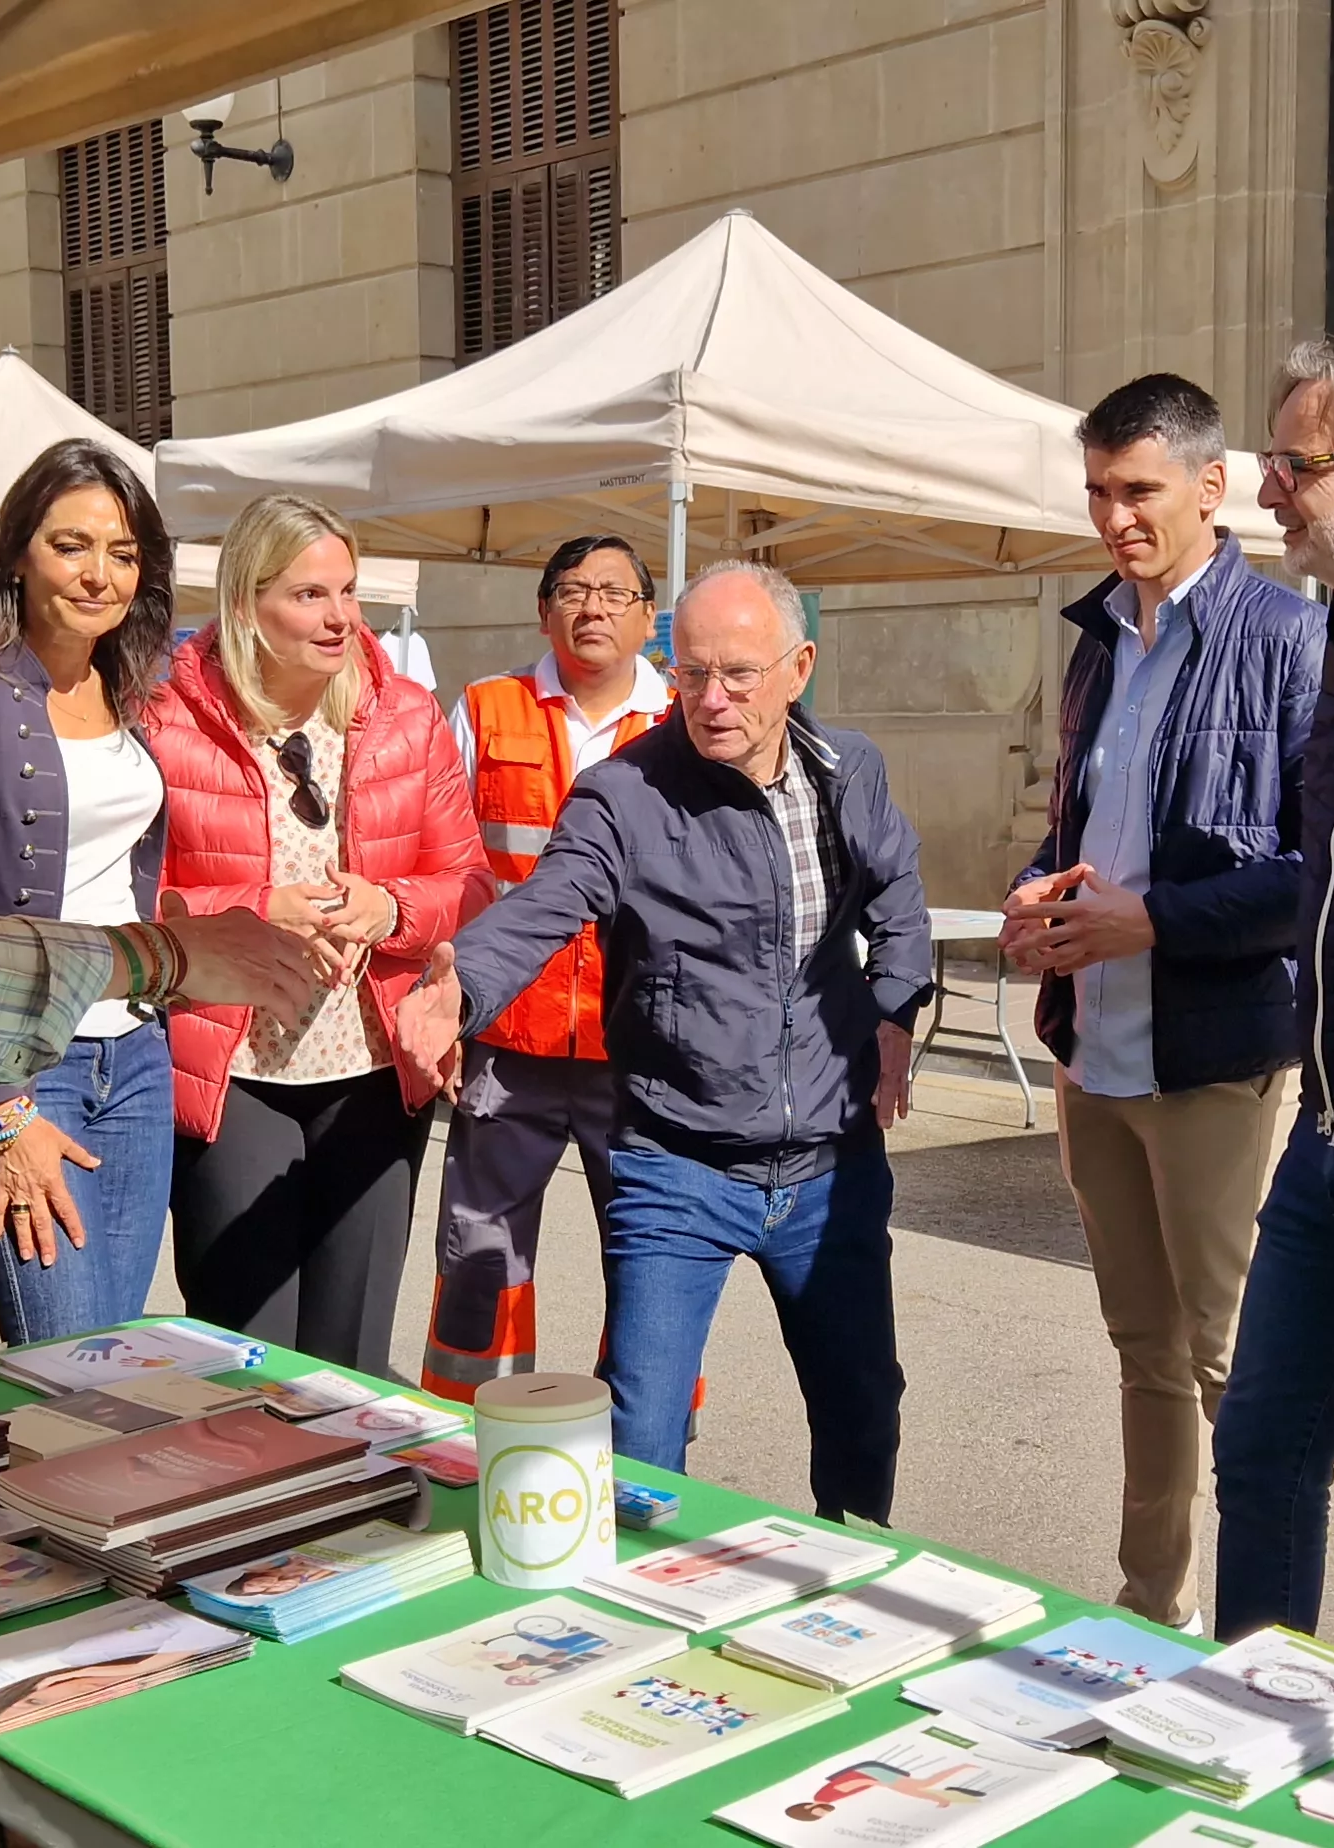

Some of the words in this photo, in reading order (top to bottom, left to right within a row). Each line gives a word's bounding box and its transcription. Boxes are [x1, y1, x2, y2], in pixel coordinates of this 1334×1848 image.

[600, 474, 646, 488] MASTERTENT
[492, 1489, 583, 1525] ARO
[597, 1479, 614, 1511] A
[597, 1518, 615, 1543] O
[647, 1681, 701, 1710] VIDA
